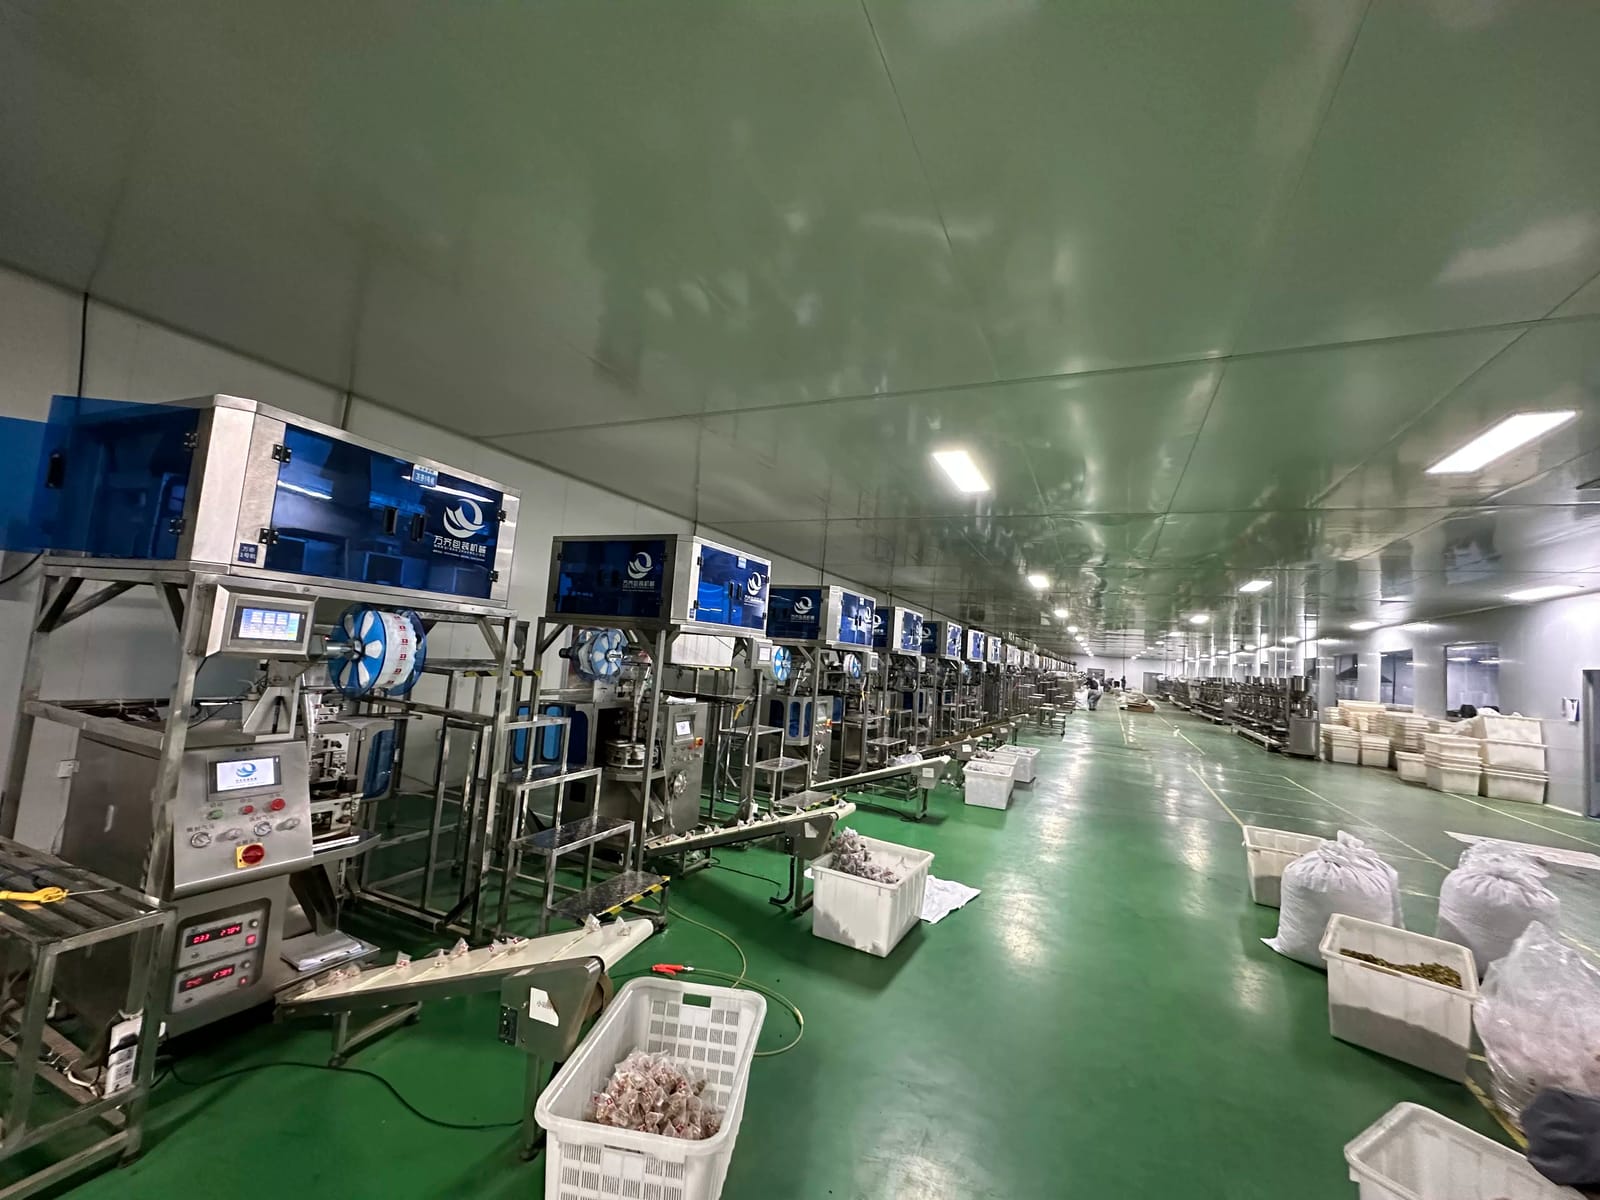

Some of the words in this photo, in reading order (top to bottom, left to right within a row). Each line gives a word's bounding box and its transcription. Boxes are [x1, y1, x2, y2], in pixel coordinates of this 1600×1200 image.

[433, 535, 488, 555] 万齐包装机械
